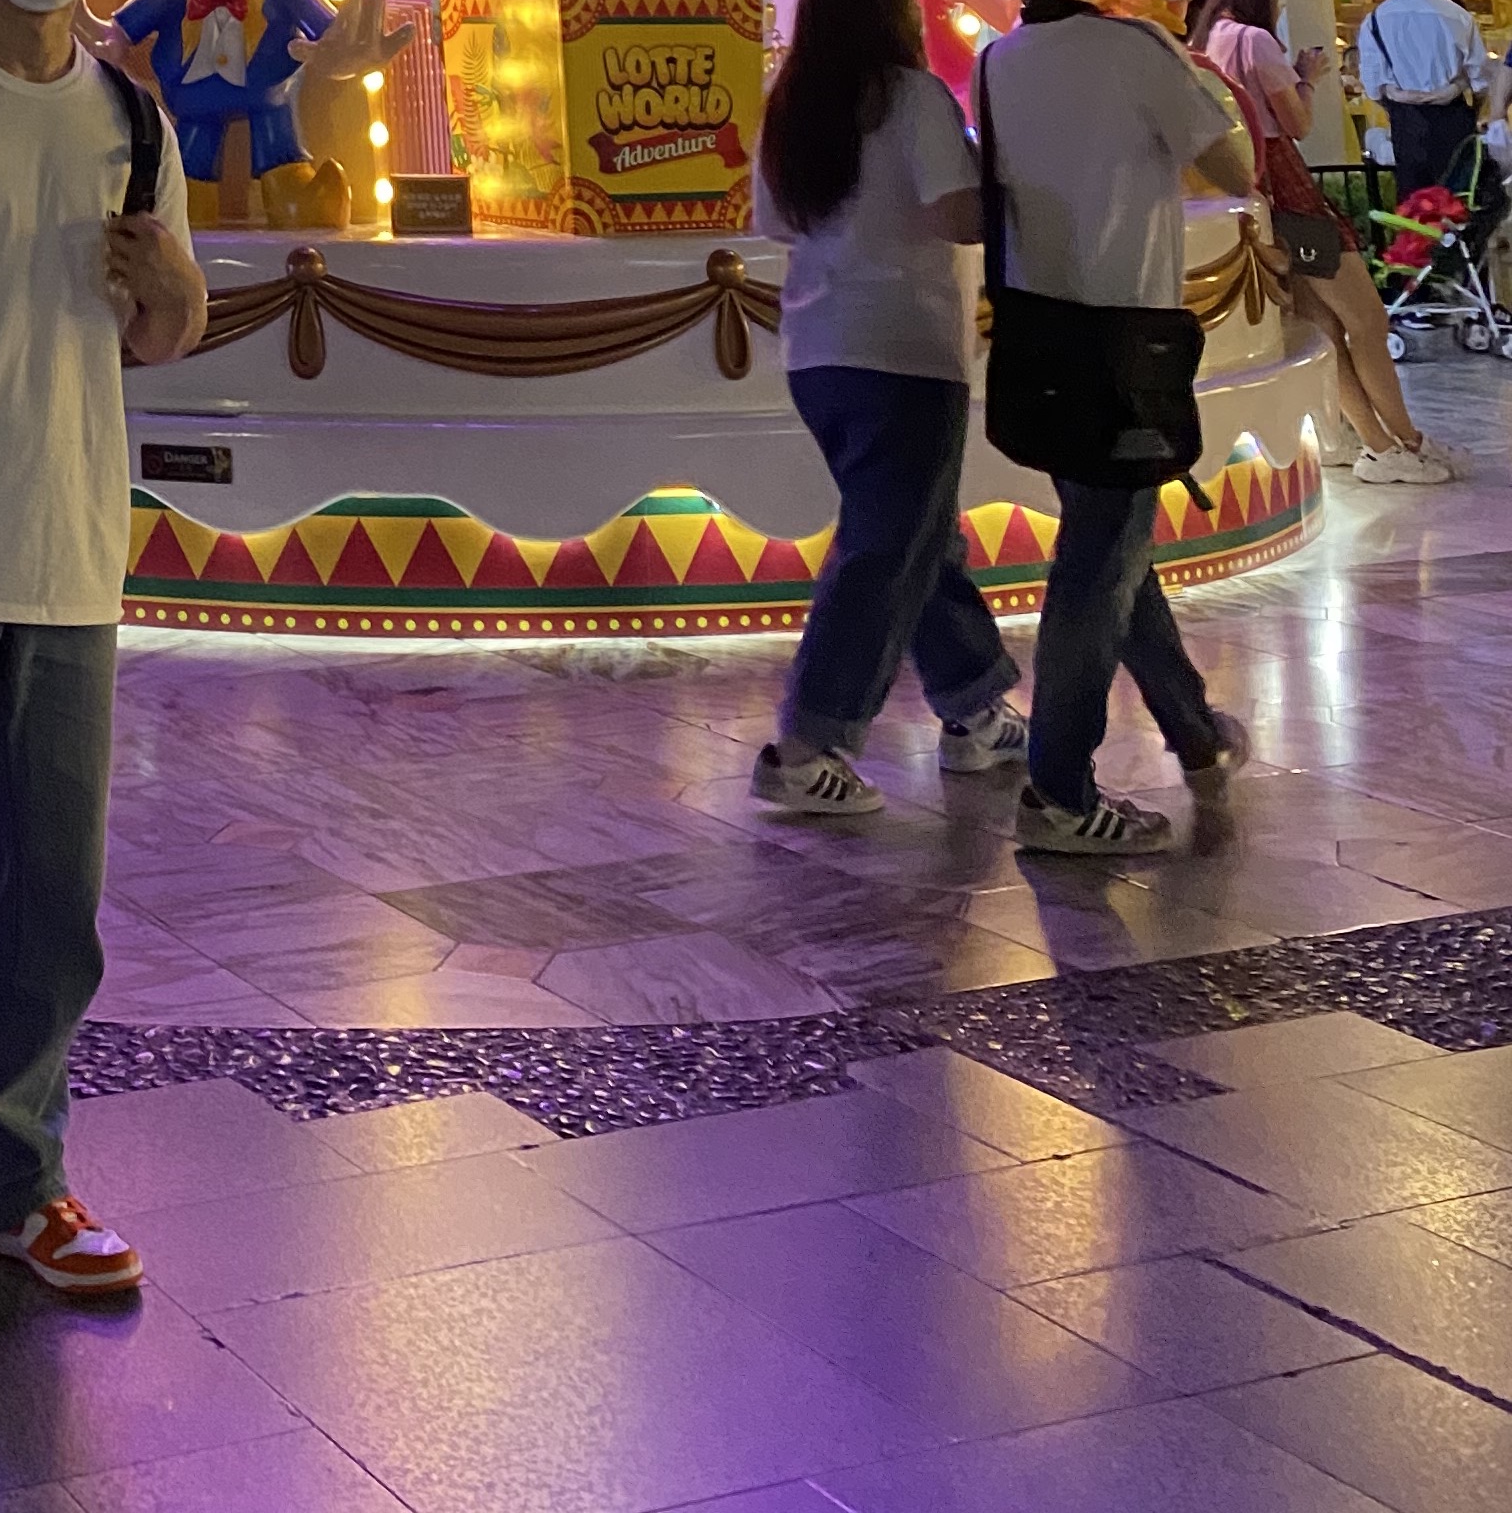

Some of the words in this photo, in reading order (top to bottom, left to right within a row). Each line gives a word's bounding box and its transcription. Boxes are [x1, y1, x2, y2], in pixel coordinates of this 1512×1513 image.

[603, 44, 716, 90] LOTTE
[596, 83, 734, 136] WORLD
[613, 134, 717, 172] Adventure
